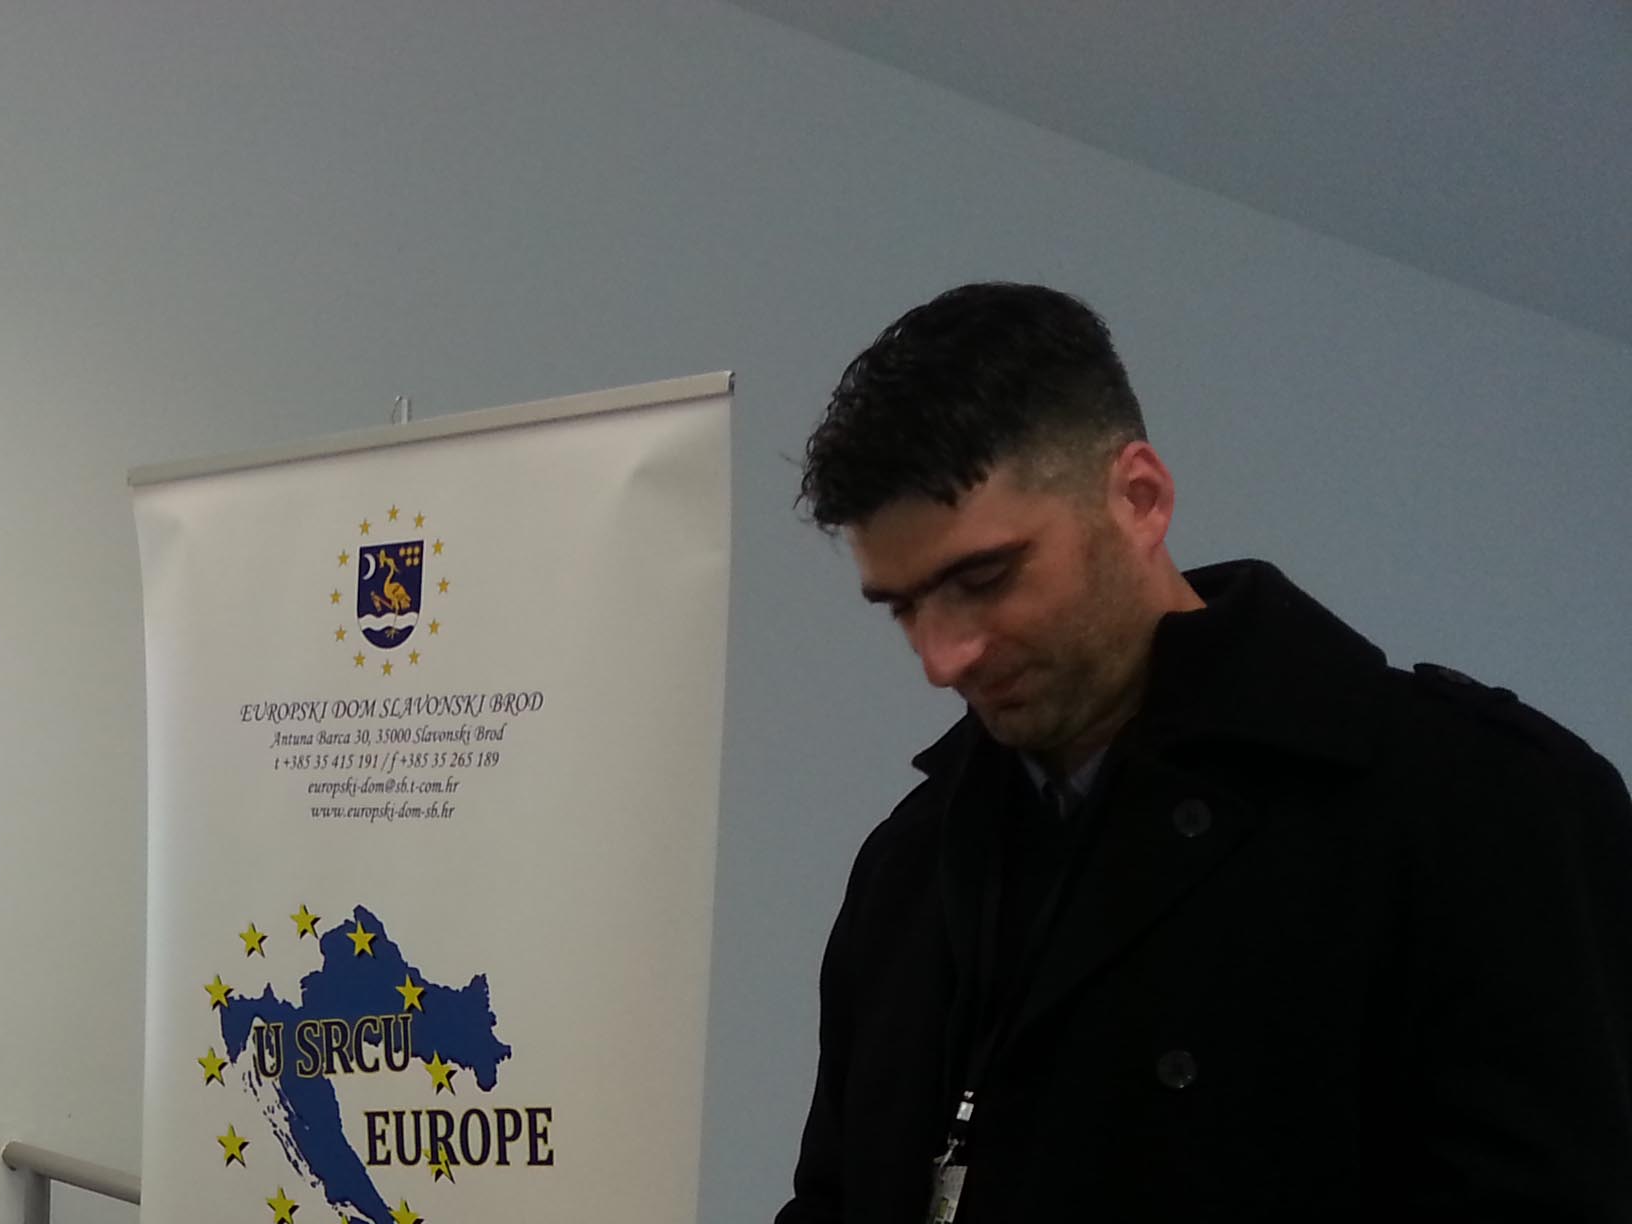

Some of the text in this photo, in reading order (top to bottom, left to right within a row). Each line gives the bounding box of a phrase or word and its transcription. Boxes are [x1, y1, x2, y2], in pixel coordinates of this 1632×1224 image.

[240, 690, 544, 724] EUROPSKI DOM SLAVONSKI BROD
[269, 721, 508, 749] Antuna Barca 30, 35000 Slavonski Brod
[282, 754, 311, 770] +385
[313, 754, 329, 770] 35
[331, 753, 354, 770] 415
[357, 753, 379, 769] 191
[399, 752, 429, 769] +385
[431, 751, 448, 768] 35
[449, 751, 474, 768] 265
[476, 750, 500, 767] 189
[307, 775, 461, 799] europski-dom@sb.t-com.hr
[310, 800, 456, 823] www.europski-dom-sb.hr
[251, 1012, 413, 1078] U SRCU
[363, 1106, 554, 1167] EUROPE
